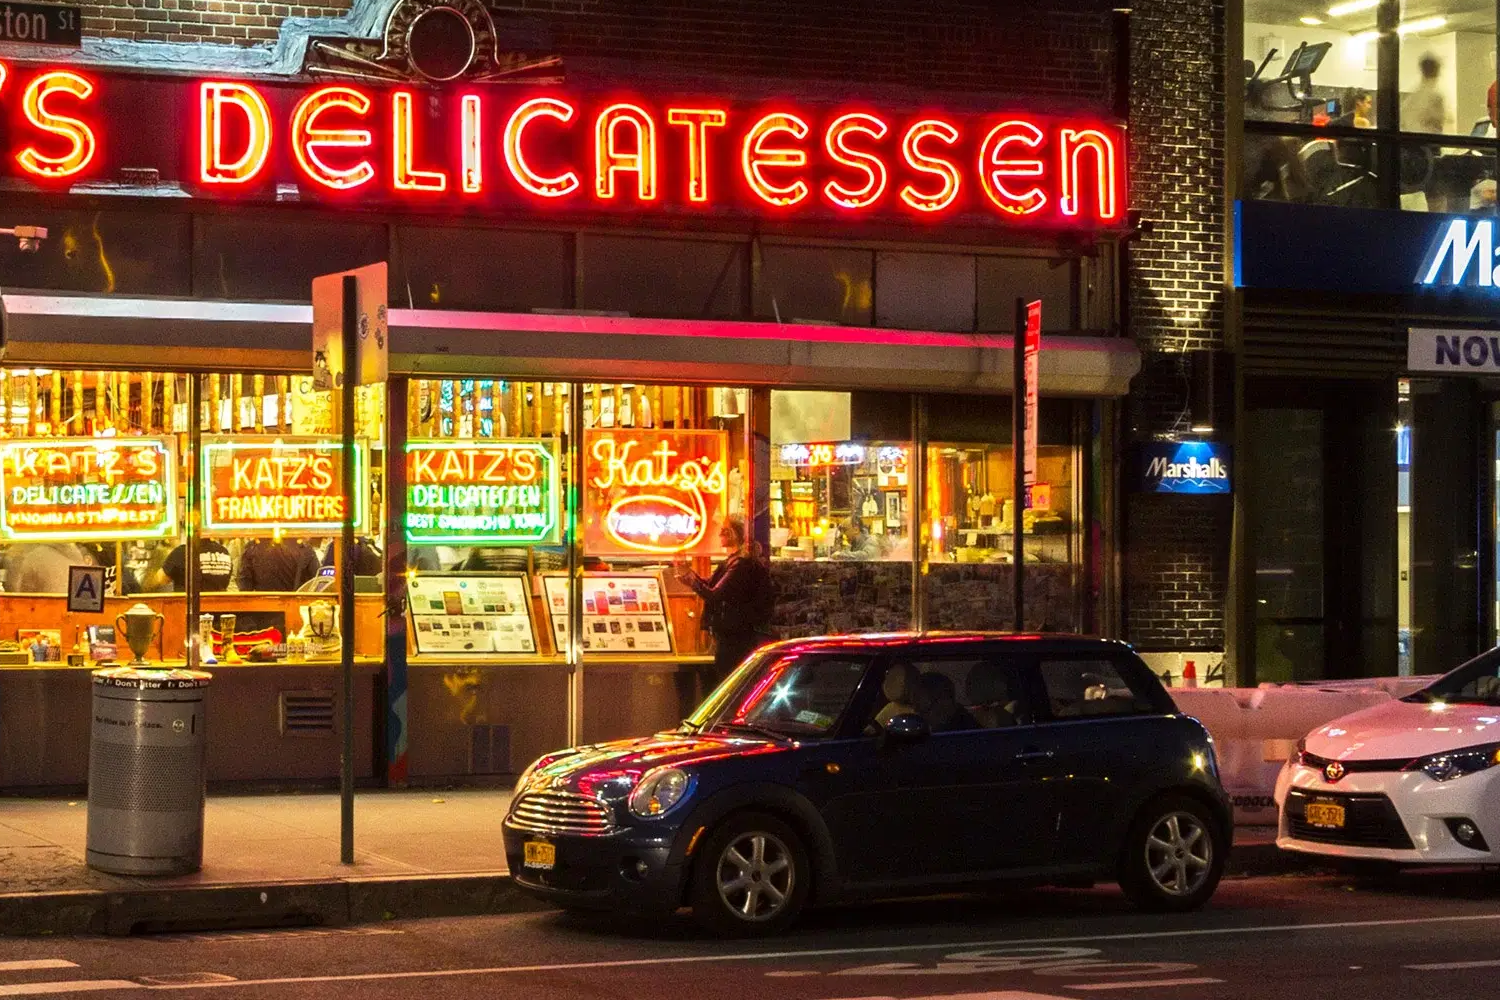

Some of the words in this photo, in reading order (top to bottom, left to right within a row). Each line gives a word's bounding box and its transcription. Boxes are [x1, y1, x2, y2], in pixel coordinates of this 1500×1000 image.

[57, 9, 75, 30] St
[199, 81, 1118, 219] DELICATESSEN
[232, 453, 333, 490] KATZ'S
[414, 448, 536, 483] KATZ'S
[592, 438, 726, 495] Katz's
[1144, 456, 1228, 479] Marshalls
[12, 483, 164, 505] DELICATESSEN
[412, 484, 541, 508] DELICATESSEN
[216, 495, 344, 520] FRANKFURTERS
[406, 512, 436, 529] BEST
[74, 573, 97, 600] A
[115, 679, 137, 688] Don't
[178, 680, 198, 688] Don't
